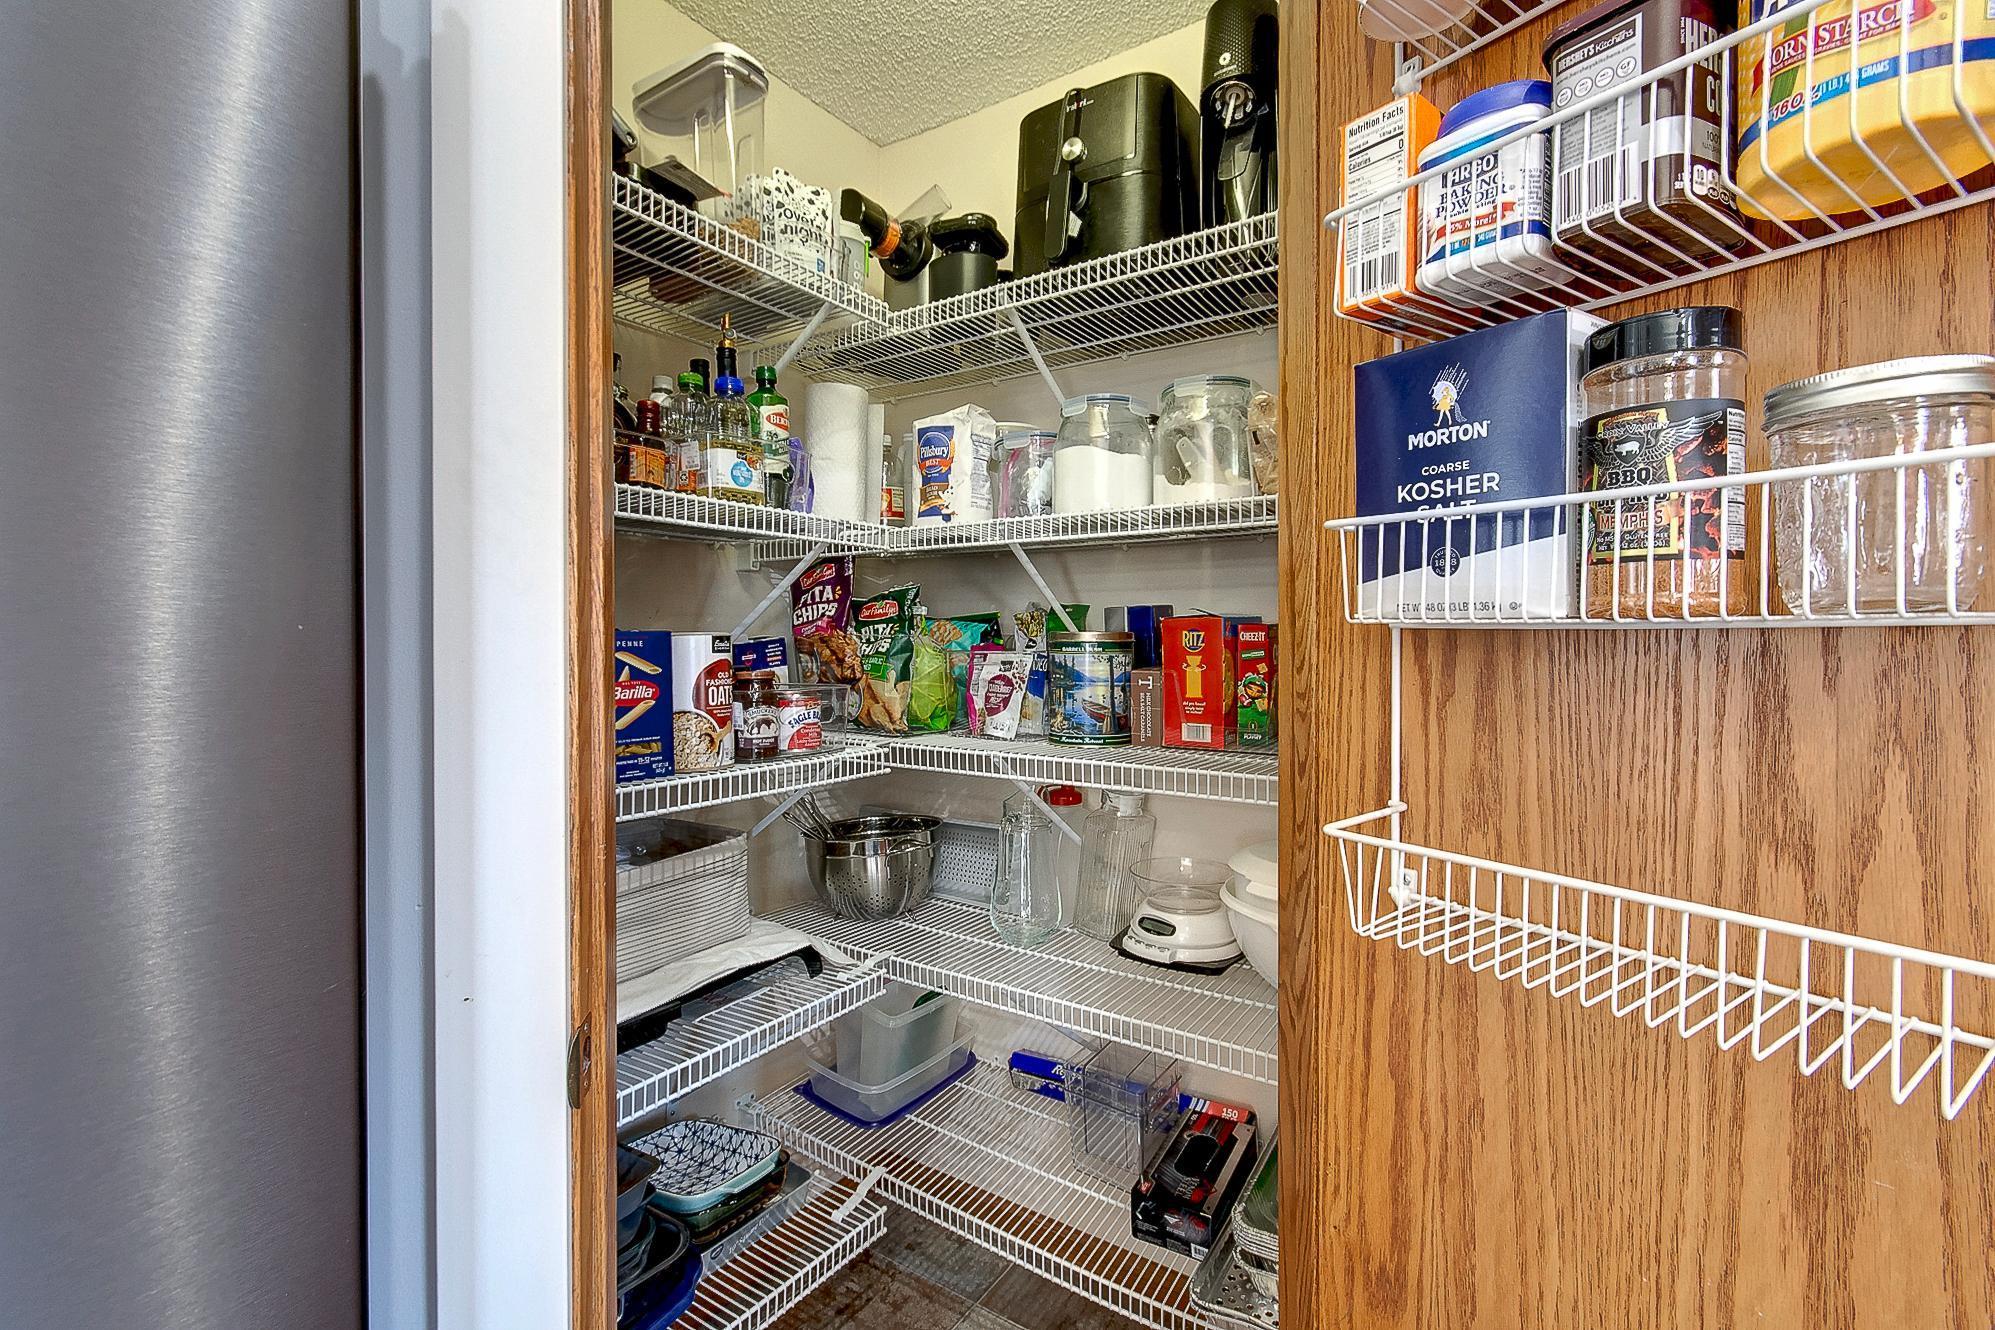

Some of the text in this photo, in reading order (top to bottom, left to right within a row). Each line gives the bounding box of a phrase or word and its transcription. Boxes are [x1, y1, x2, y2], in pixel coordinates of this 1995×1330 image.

[1766, 34, 1808, 66] ORN
[1861, 60, 1890, 78] GRAMS
[1348, 116, 1381, 139] Nutrition
[1382, 106, 1405, 122] Facts
[1348, 157, 1371, 172] Calories
[1408, 421, 1489, 450] MORTON
[920, 445, 949, 460] Pillsbury
[1421, 460, 1470, 476] COARSE
[1607, 466, 1653, 487] BBQ
[1397, 472, 1500, 504] KOSHER
[1600, 509, 1664, 530] MEMPHS
[1434, 558, 1457, 567] 188
[799, 585, 834, 608] PITA
[793, 602, 838, 626] CHIPS
[859, 638, 892, 656] HIPS
[1182, 630, 1205, 647] RITZ
[614, 685, 653, 700] Barilla
[1222, 1107, 1239, 1119] 150
